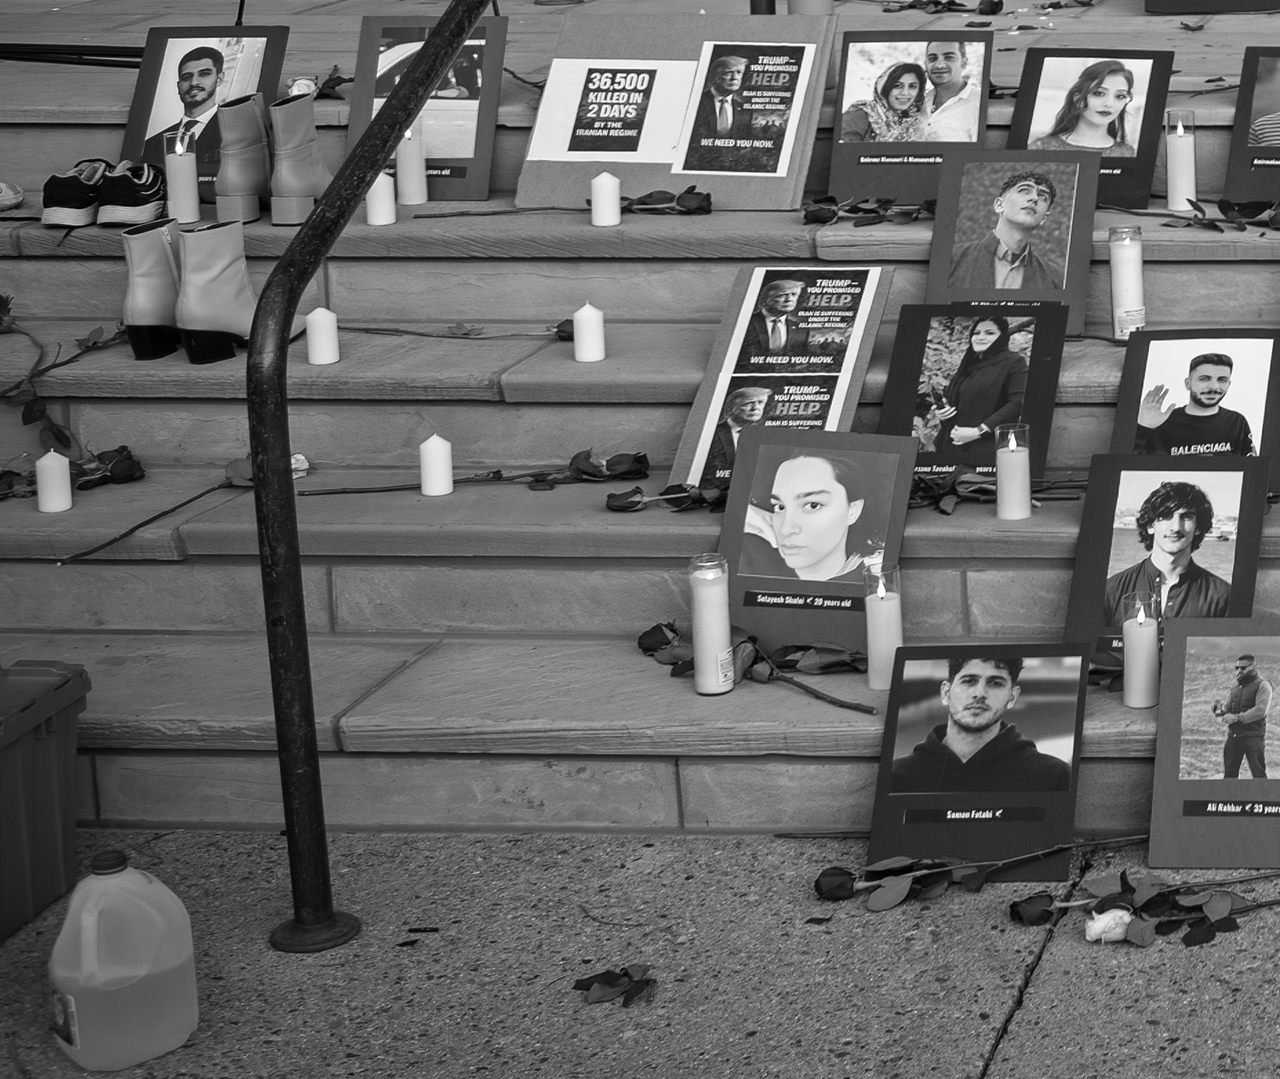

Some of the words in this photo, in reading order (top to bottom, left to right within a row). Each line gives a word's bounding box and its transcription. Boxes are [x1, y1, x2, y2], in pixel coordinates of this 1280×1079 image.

[588, 72, 651, 92] 36,500
[587, 91, 629, 104] KILLED
[628, 92, 645, 104] IN
[586, 104, 601, 118] 2
[600, 104, 640, 118] DAYS
[593, 121, 607, 129] BY
[606, 121, 624, 129] THE
[575, 128, 609, 137] IRANIAN
[608, 128, 640, 137] REGIME
[700, 137, 715, 147] WE
[714, 138, 736, 148] NEED
[736, 138, 753, 148] YOU
[753, 139, 776, 149] NOW.
[806, 286, 823, 294] YOU
[822, 286, 862, 295] PROMISED
[749, 355, 765, 364] WE
[765, 355, 790, 364] NEED
[790, 356, 809, 365] YOU
[808, 356, 834, 365] NOW.
[773, 393, 790, 402] YOU
[789, 393, 831, 402] PROMISED
[764, 419, 781, 427] IRAN
[780, 419, 788, 427] IS
[787, 419, 823, 427] SUFFERING
[1170, 441, 1233, 457] BALENCIAGA
[715, 467, 732, 479] WE
[823, 598, 841, 609] years
[841, 599, 853, 609] old
[946, 809, 971, 820] Saman
[1253, 804, 1264, 814] 33
